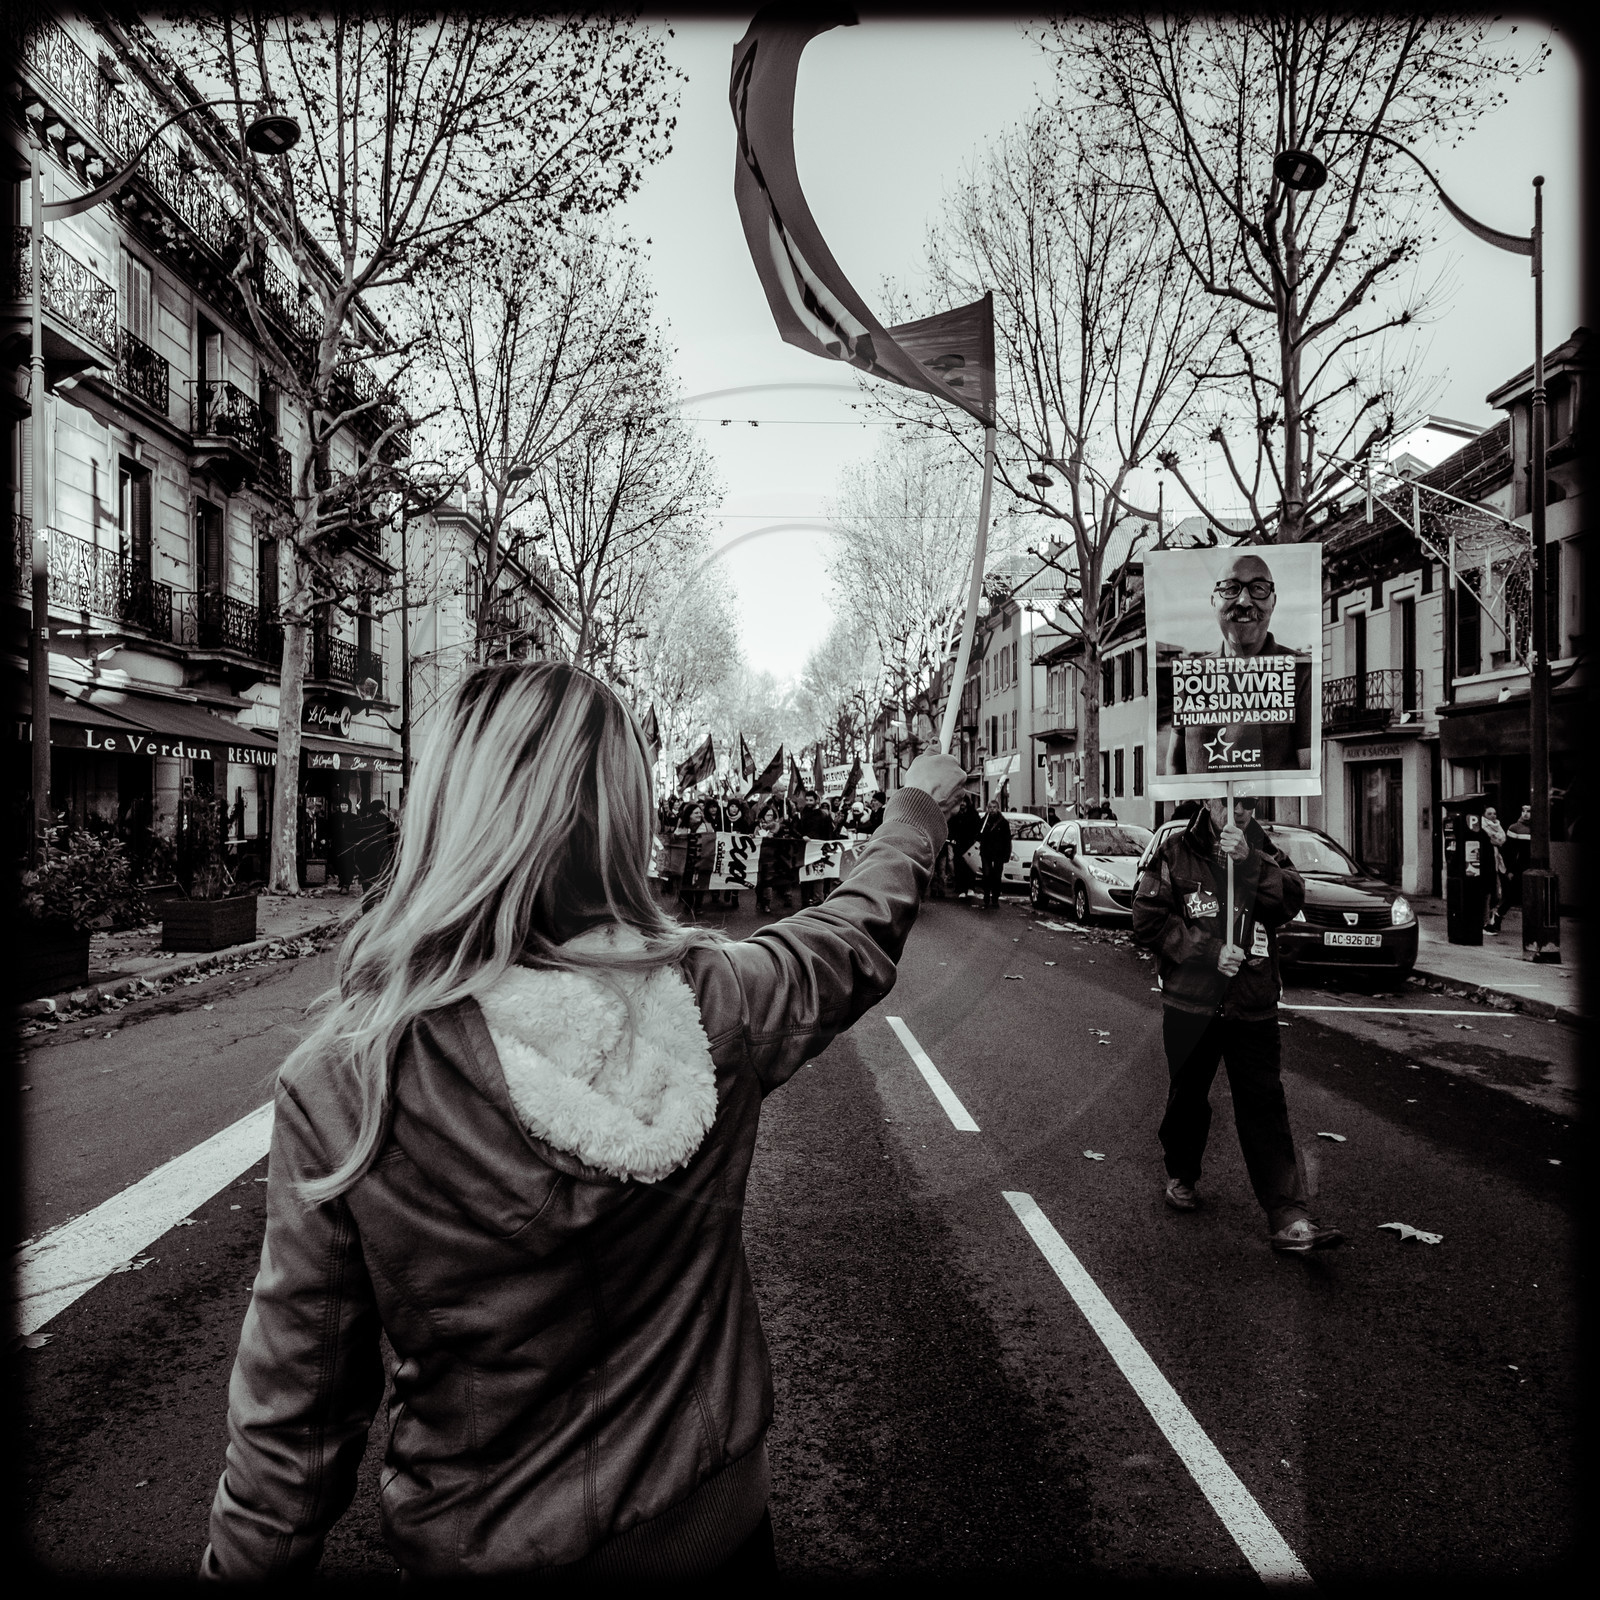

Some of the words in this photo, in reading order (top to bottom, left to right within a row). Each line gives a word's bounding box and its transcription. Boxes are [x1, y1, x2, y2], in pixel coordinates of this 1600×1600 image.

[1172, 658, 1203, 675] DES
[1205, 655, 1296, 674] RETRAITES
[1172, 674, 1231, 695] POUR
[1233, 671, 1296, 693] VIVRE
[1173, 694, 1206, 714] PAS
[1208, 691, 1296, 710] SURVIVRE
[1173, 712, 1232, 726] L'HUMAIN
[85, 729, 116, 751] Le
[126, 734, 212, 761] Verdun
[1232, 748, 1262, 763] PCF
[1202, 900, 1217, 911] PCF
